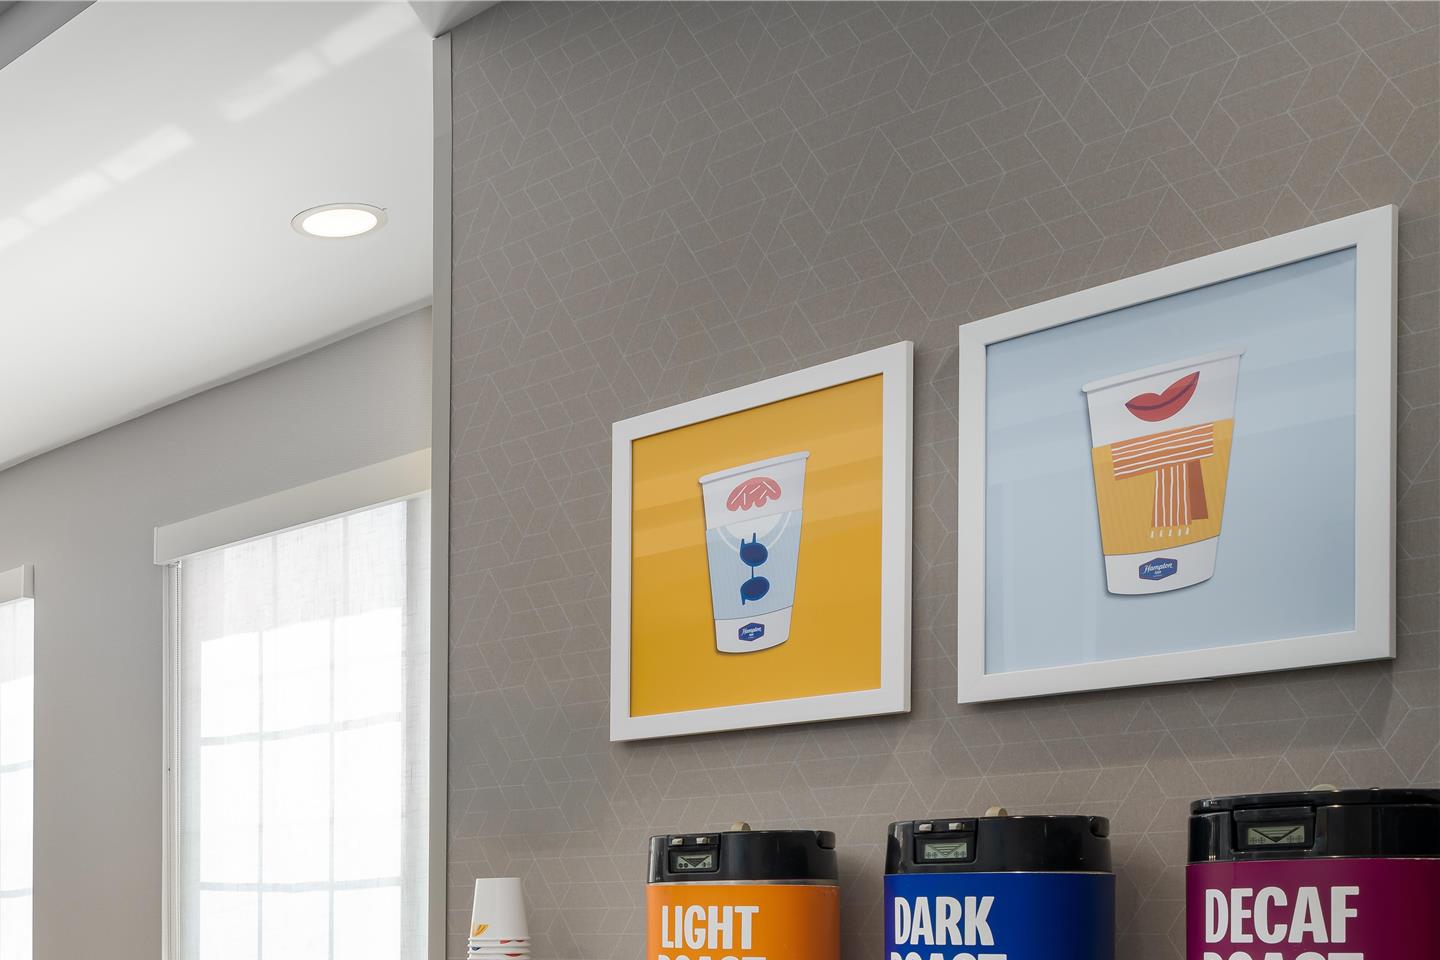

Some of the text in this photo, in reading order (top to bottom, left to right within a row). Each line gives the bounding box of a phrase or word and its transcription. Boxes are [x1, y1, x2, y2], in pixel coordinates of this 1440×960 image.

[1143, 562, 1173, 574] Hampton
[741, 627, 762, 635] Hampton
[662, 905, 759, 950] LIGHT
[895, 896, 995, 946] DARK
[1205, 886, 1359, 944] DECAF
